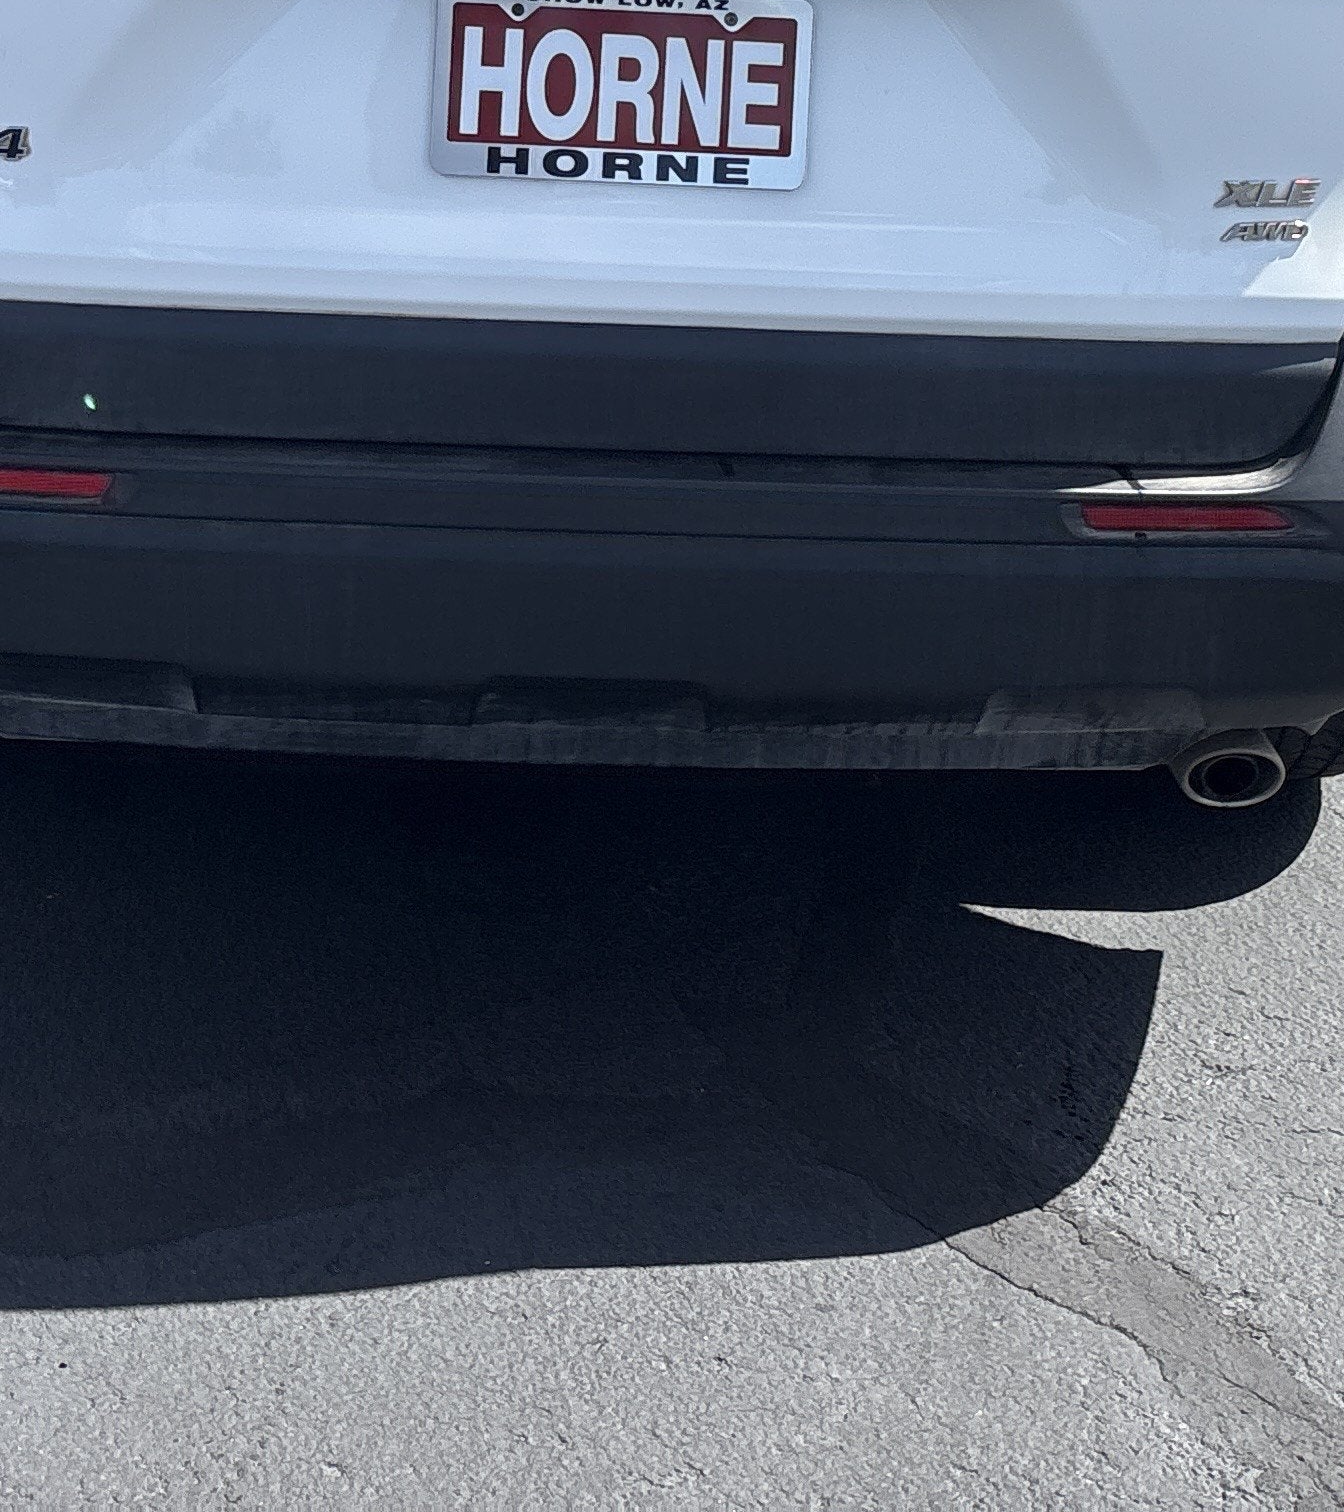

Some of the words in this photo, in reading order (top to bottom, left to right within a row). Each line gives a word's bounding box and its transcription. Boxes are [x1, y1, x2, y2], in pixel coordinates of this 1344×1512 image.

[695, 0, 730, 11] AZ
[458, 25, 786, 150] HORNE
[486, 146, 751, 185] HORNE
[1213, 177, 1322, 208] XLE
